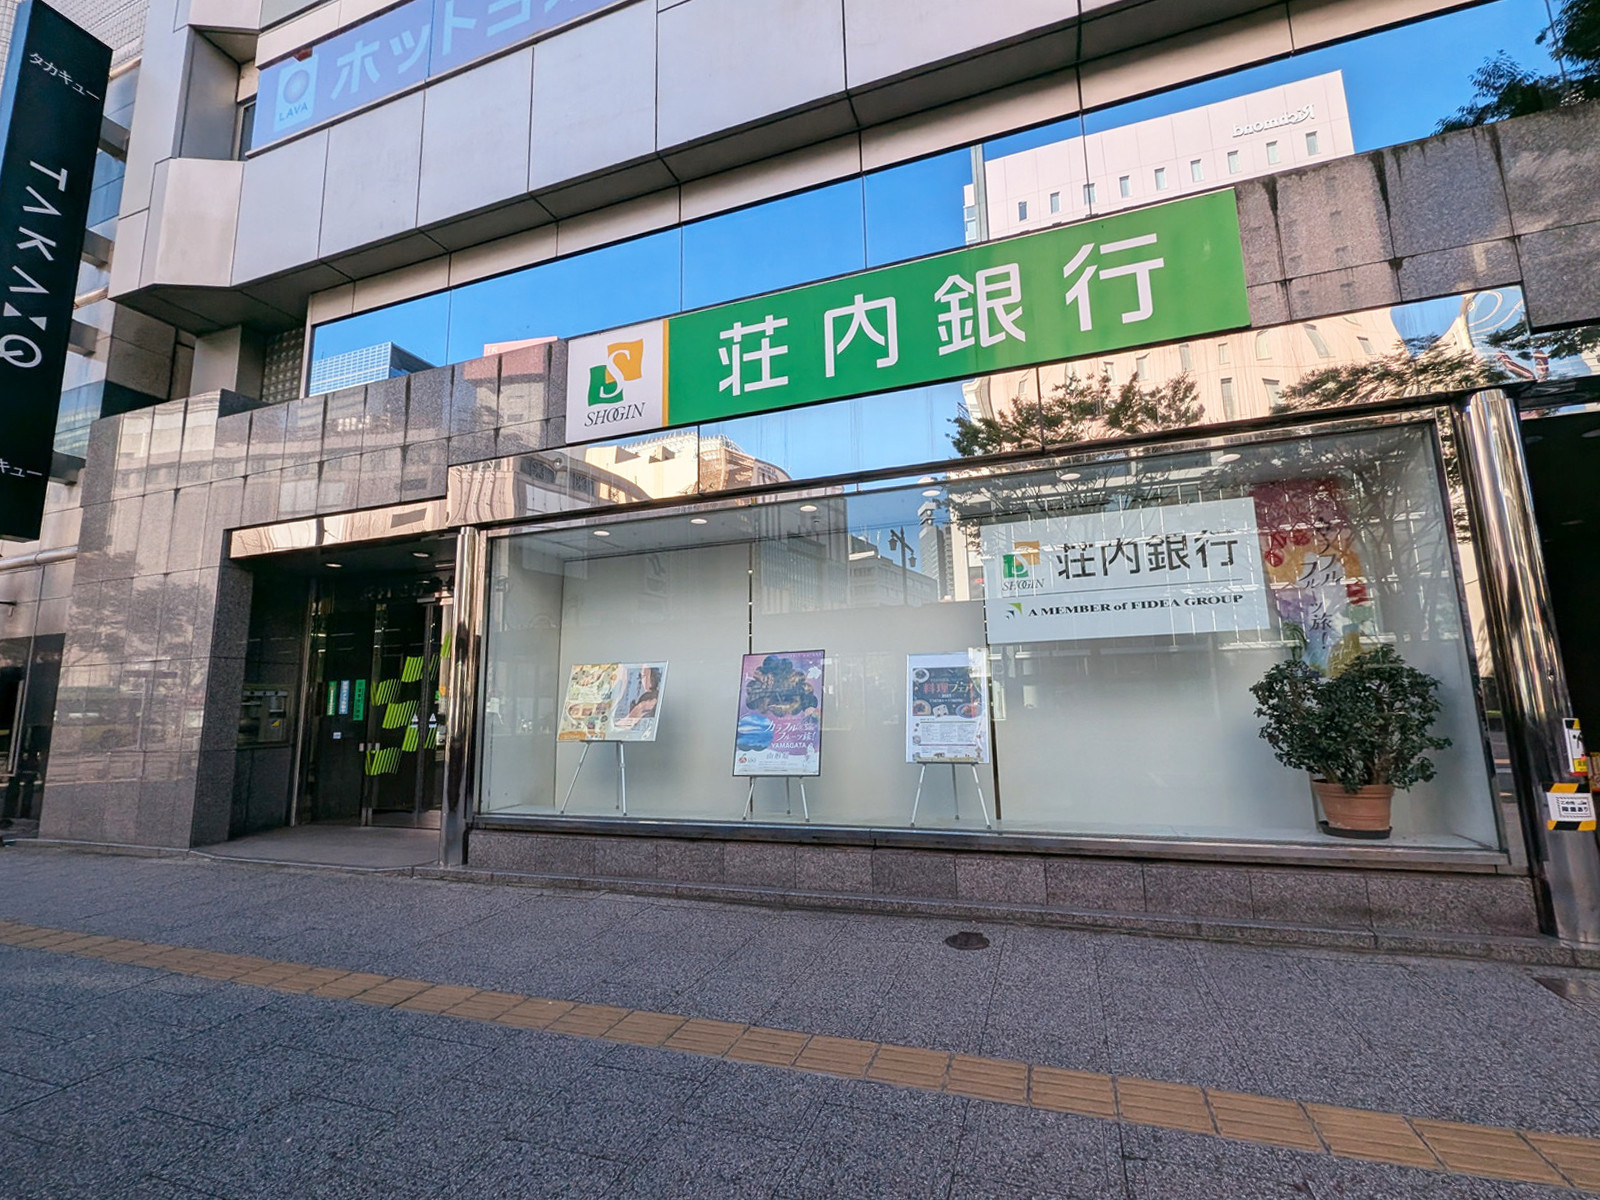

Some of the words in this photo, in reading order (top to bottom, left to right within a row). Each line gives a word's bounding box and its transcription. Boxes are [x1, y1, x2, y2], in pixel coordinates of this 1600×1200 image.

[29, 53, 100, 100] タカキュー
[278, 102, 309, 122] LAVA
[718, 232, 1165, 397] 荘内銀行
[584, 402, 646, 427] SHOGIN
[1057, 530, 1239, 580] 荘内銀行
[1027, 608, 1038, 617] A
[1040, 603, 1110, 616] MEMBER
[1113, 601, 1128, 611] of
[1131, 598, 1181, 610] FIDEA
[1184, 594, 1243, 606] GROUP
